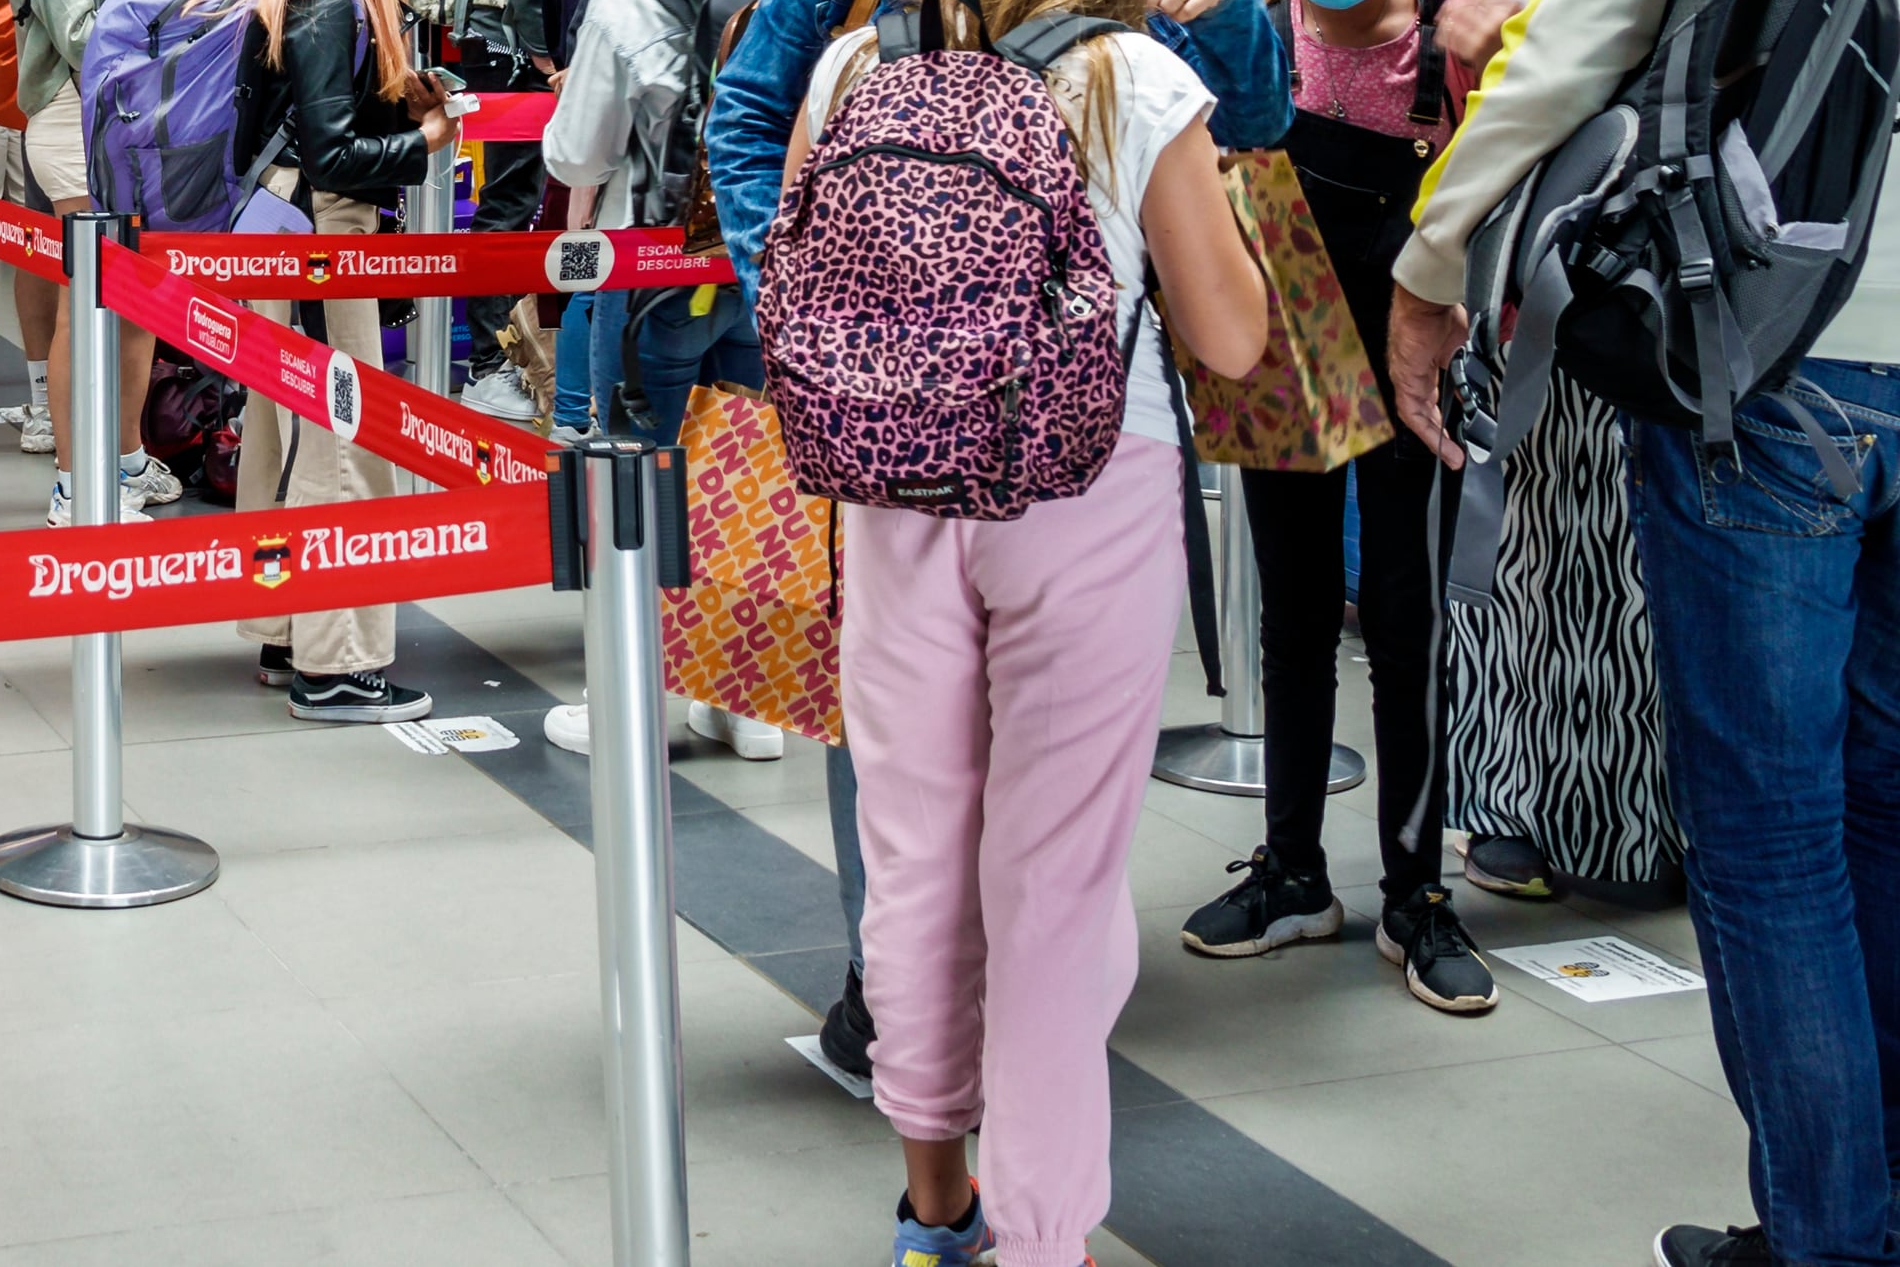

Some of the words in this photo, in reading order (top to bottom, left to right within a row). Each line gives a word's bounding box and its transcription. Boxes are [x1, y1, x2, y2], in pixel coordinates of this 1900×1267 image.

[33, 227, 63, 261] Aleman
[637, 245, 684, 257] ESCAN
[166, 249, 301, 282] Droguería
[336, 250, 458, 275] Alemana
[636, 257, 711, 271] DESCUBRE
[280, 348, 312, 376] ESCANEA
[281, 368, 316, 399] DESCUBRE
[401, 401, 474, 469] Droguería
[494, 442, 548, 483] Alema
[897, 485, 955, 497] EASTPAK
[28, 539, 243, 600] Droguería
[300, 520, 489, 571] Alemana
